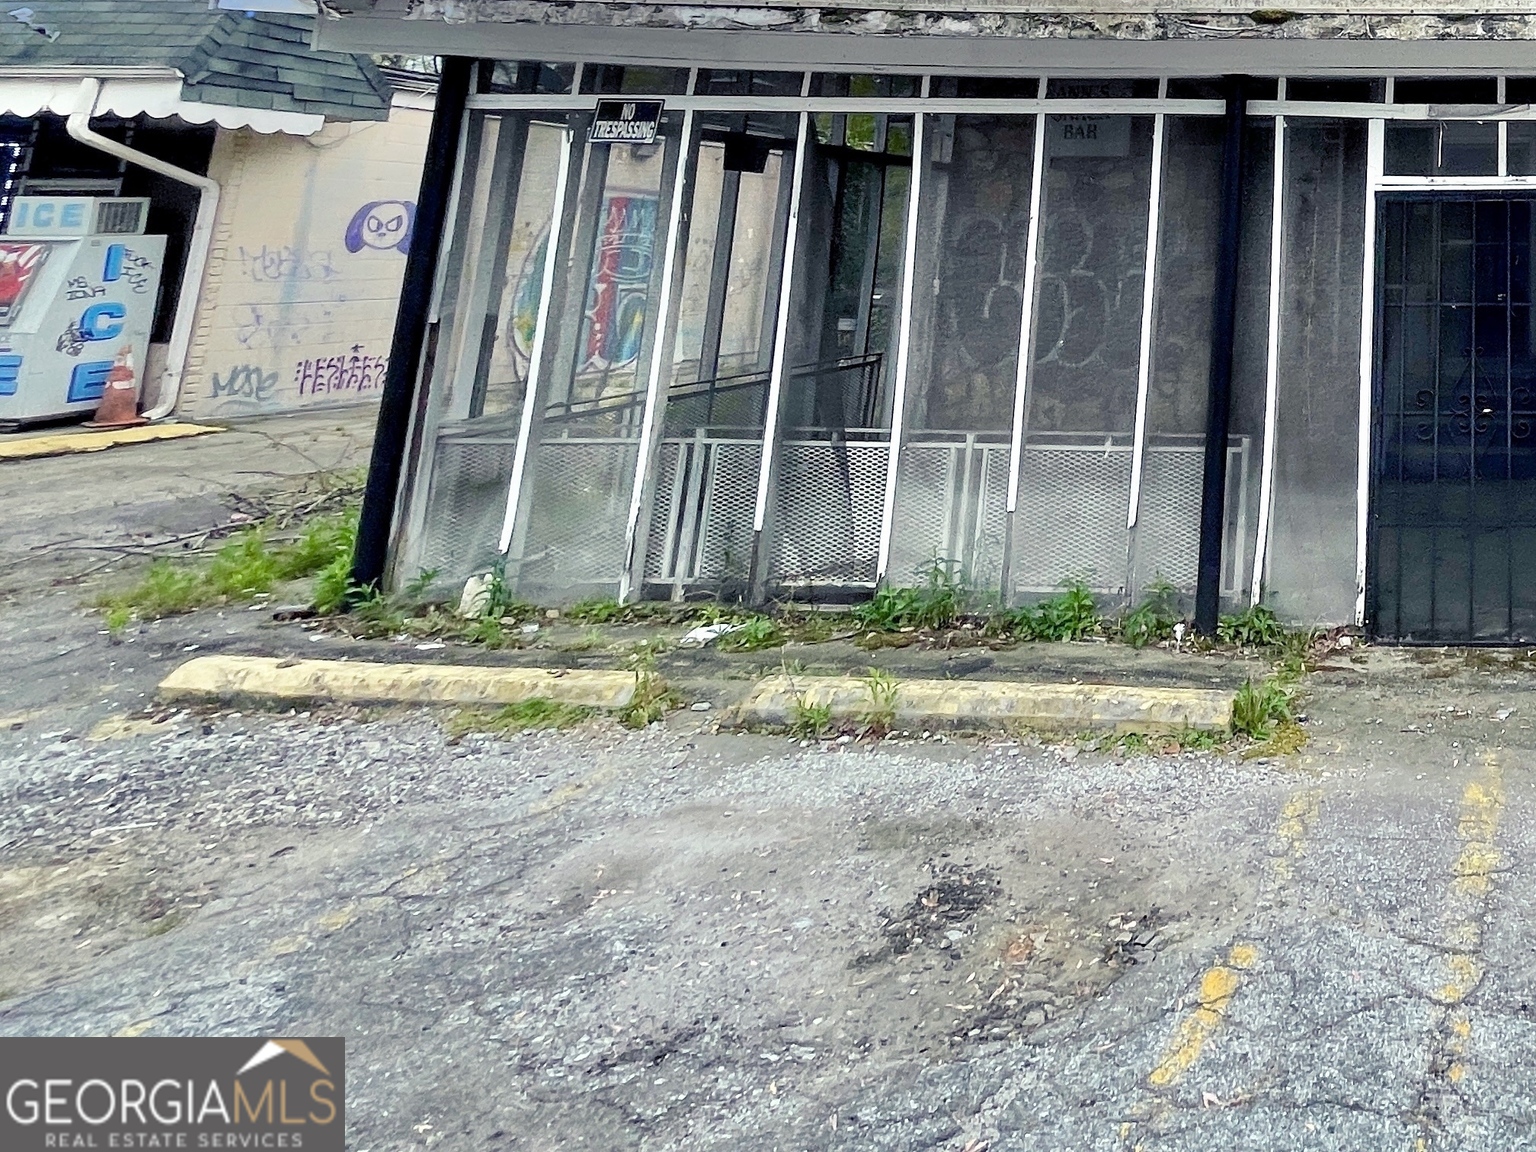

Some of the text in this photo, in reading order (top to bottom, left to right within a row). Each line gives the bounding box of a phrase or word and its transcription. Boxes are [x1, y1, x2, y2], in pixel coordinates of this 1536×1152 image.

[620, 103, 636, 120] NO
[593, 120, 655, 138] TRESPASSING
[1063, 123, 1098, 140] BAR
[16, 202, 86, 228] ICE
